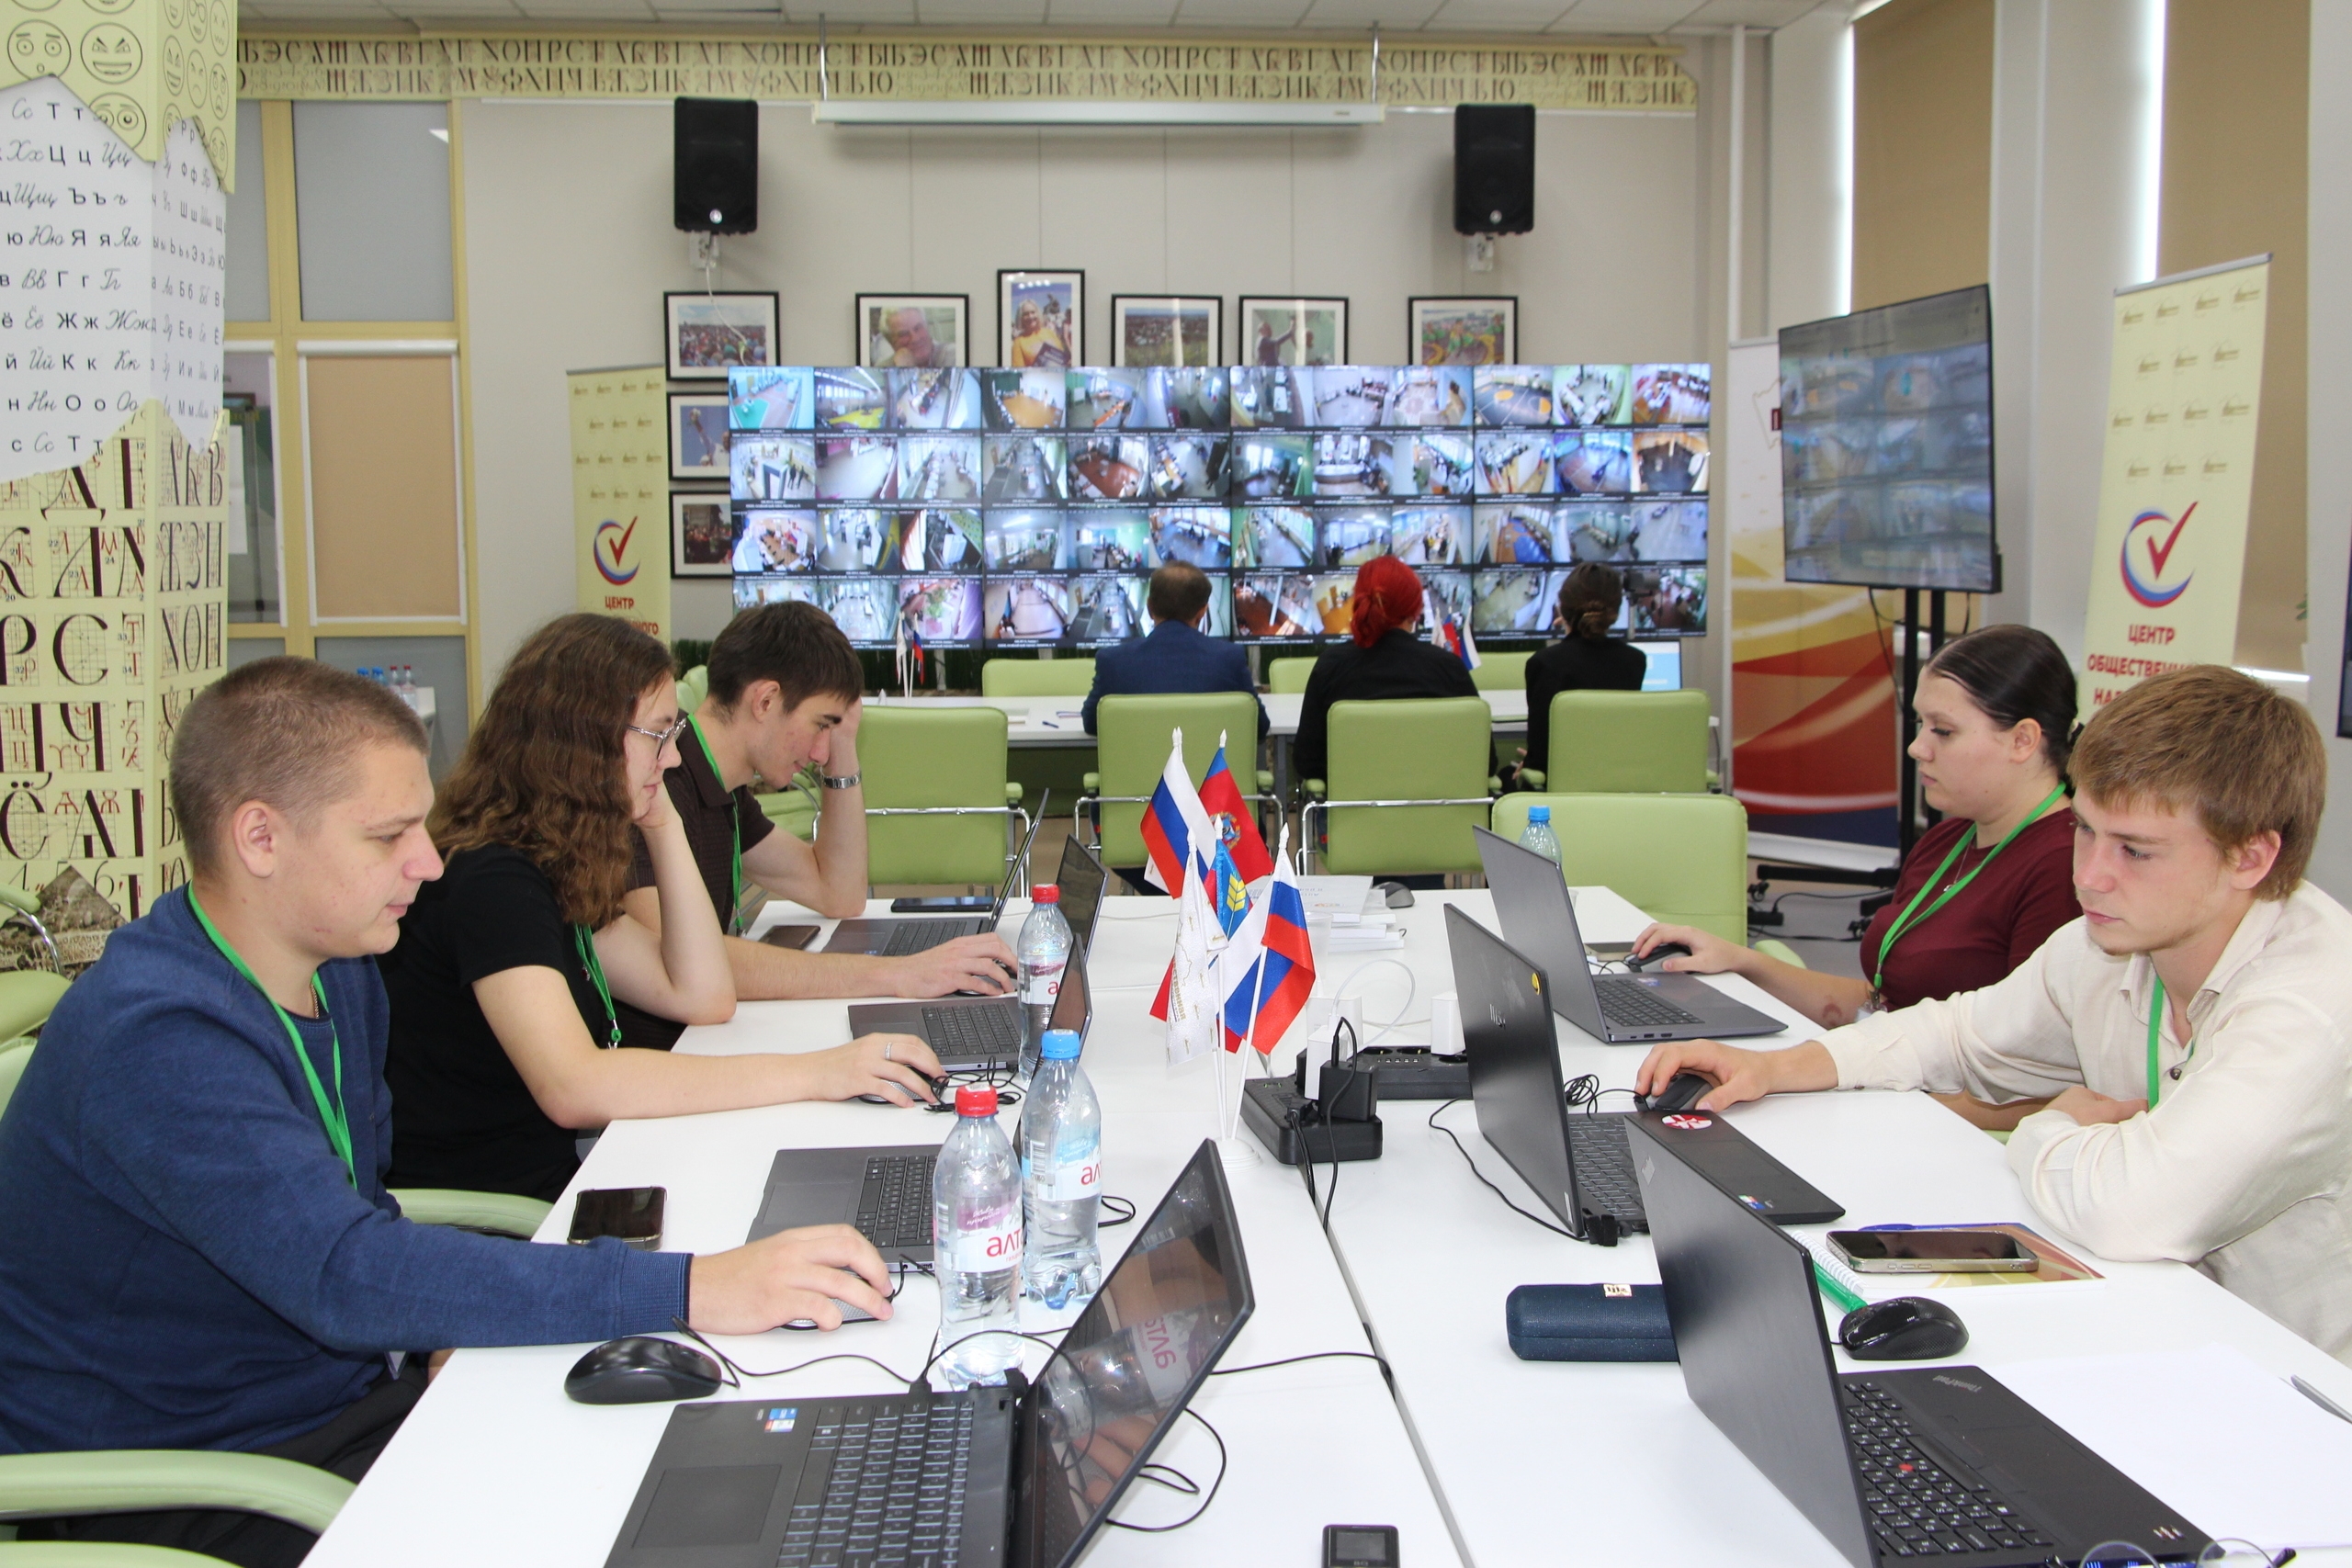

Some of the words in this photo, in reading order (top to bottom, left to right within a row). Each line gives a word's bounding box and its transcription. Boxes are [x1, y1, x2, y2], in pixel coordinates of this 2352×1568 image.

[50, 145, 65, 166] Ц
[79, 150, 91, 165] ц
[68, 187, 86, 205] Ъ
[93, 191, 107, 205] ъ
[7, 231, 23, 246] ю
[72, 230, 85, 246] Я
[100, 233, 110, 246] я
[58, 271, 69, 288] Г
[57, 312, 77, 330] Ж
[84, 316, 98, 330] ж
[6, 352, 17, 369] й
[62, 354, 74, 370] К
[65, 394, 81, 411] О
[68, 435, 81, 452] Т
[605, 595, 634, 610] ЦЕНТР
[2128, 625, 2176, 646] ЦЕНТР
[52, 614, 108, 686] С
